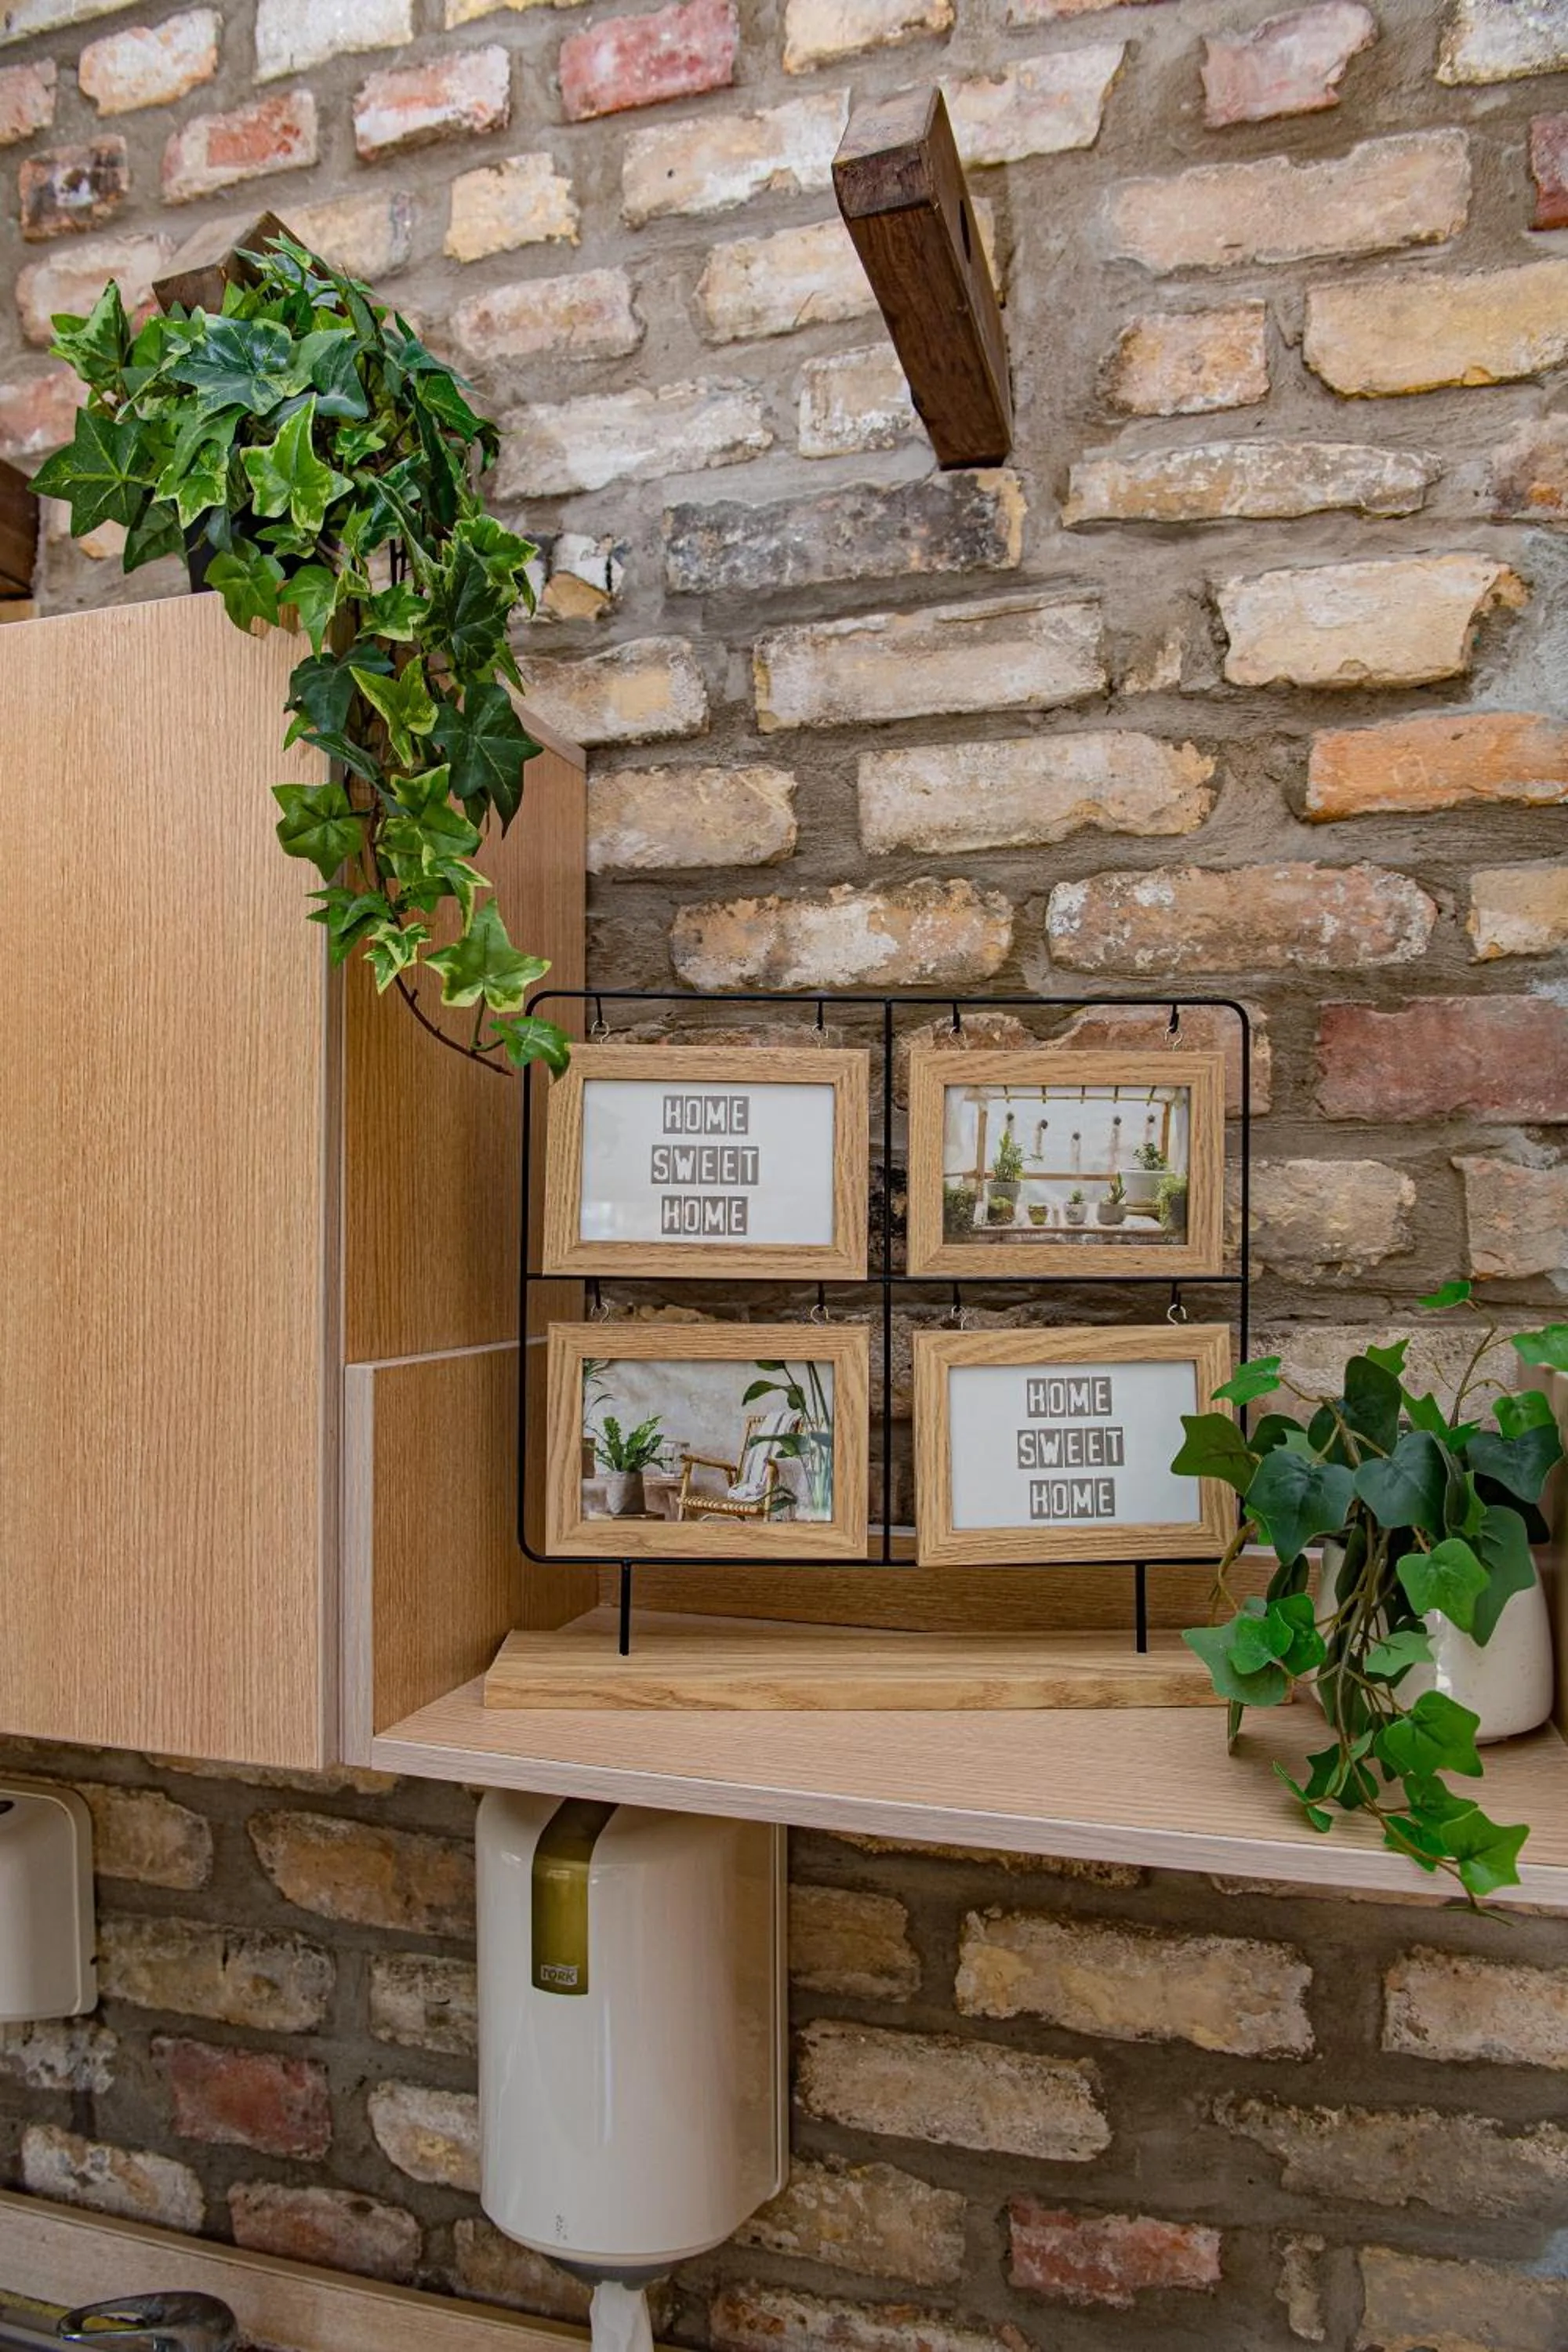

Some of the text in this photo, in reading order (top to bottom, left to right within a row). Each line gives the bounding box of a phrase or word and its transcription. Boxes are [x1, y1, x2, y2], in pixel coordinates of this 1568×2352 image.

[665, 1098, 747, 1133] HOME
[652, 1147, 758, 1183] SWEET
[662, 1198, 746, 1232] HOME
[1028, 1380, 1110, 1415] HOME
[1018, 1429, 1123, 1466] SWEET
[1031, 1481, 1113, 1516] HOME
[542, 1965, 576, 1984] TORK
